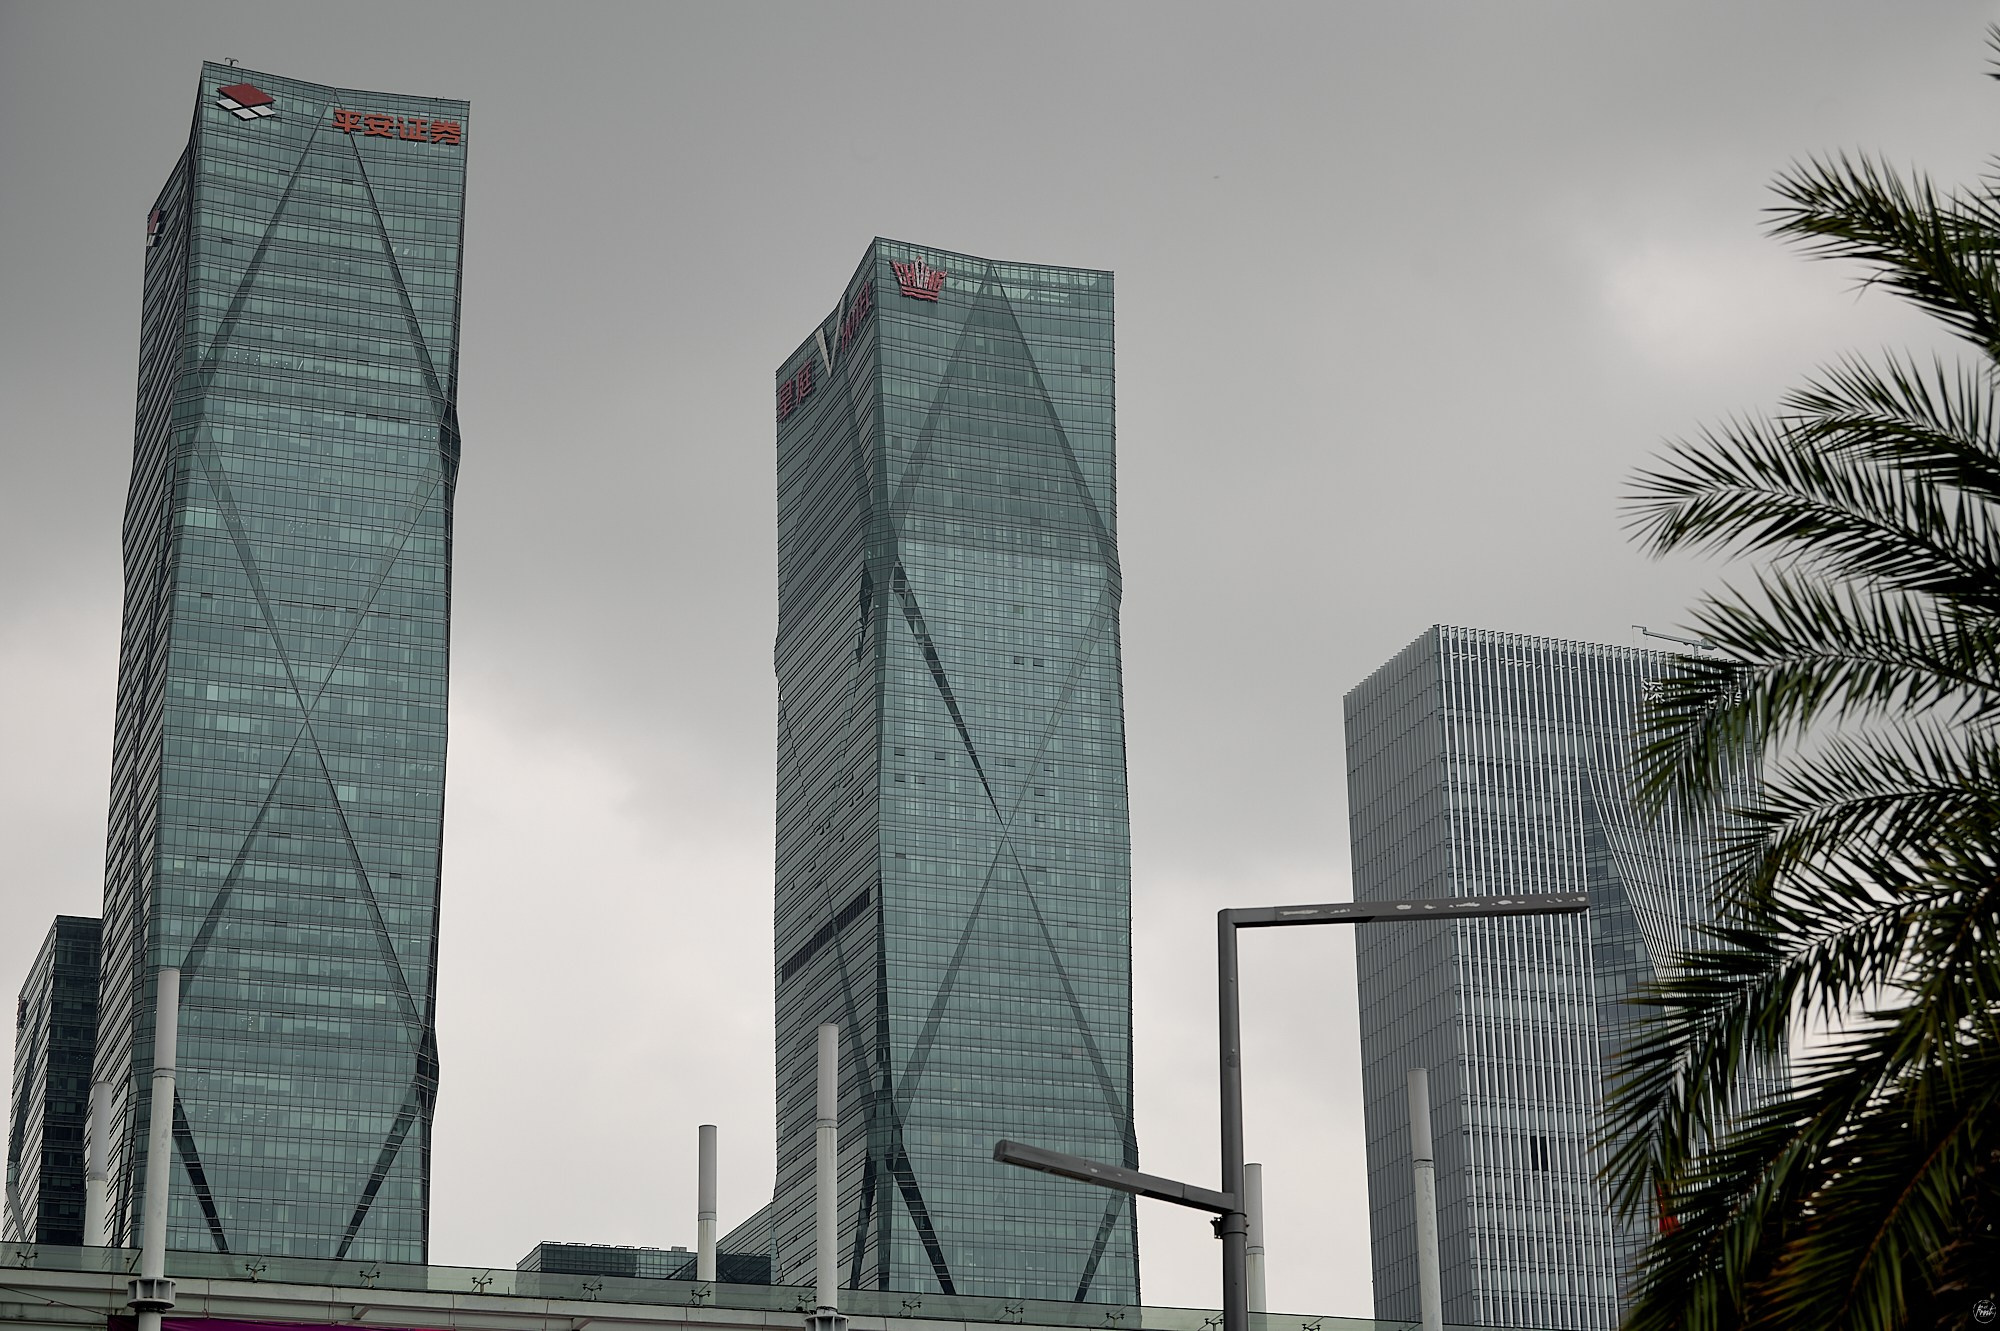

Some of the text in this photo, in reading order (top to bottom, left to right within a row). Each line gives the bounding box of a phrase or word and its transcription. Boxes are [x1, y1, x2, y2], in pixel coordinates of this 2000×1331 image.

[332, 109, 461, 144] 平安证券
[777, 281, 872, 423] 皇庭 V HOTEL
